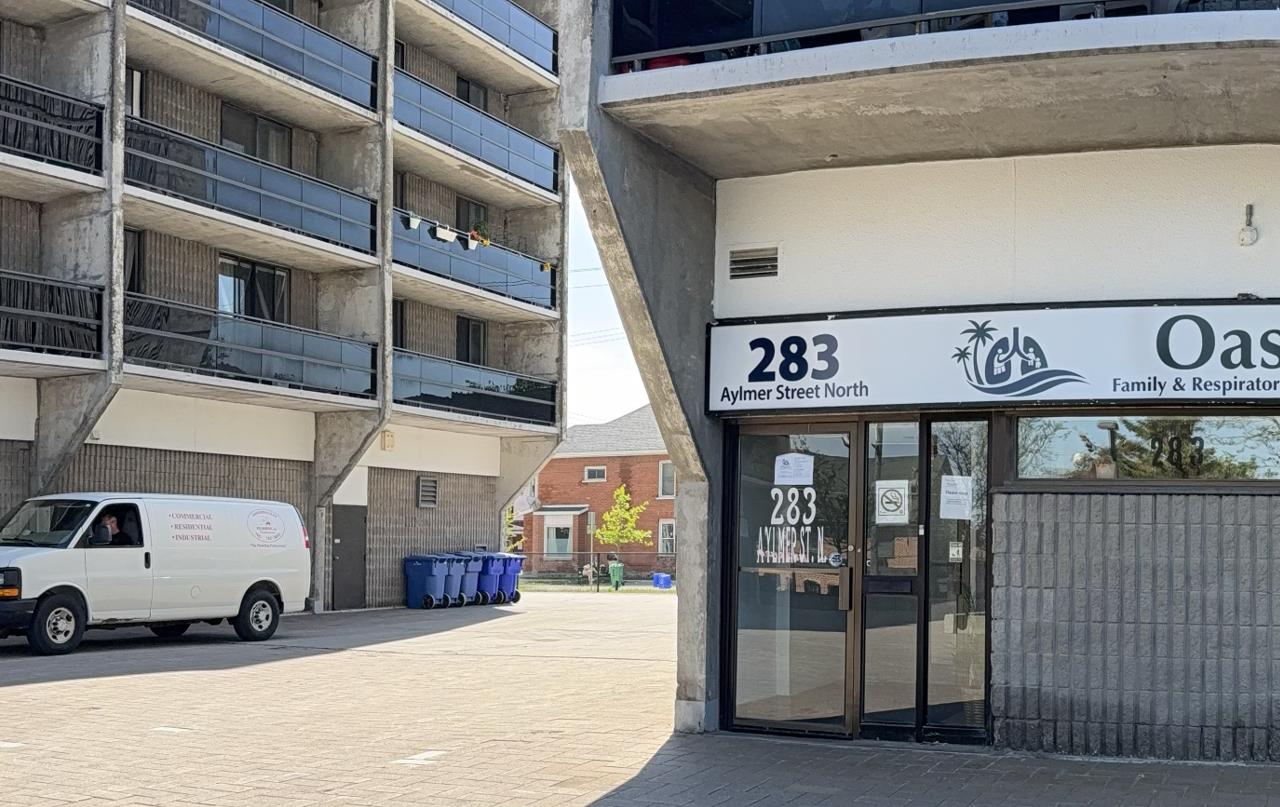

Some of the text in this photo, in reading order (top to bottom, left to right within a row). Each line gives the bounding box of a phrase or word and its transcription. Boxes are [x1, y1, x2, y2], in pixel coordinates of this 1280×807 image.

[748, 333, 839, 382] 283
[721, 381, 868, 405] Aylmer Street North
[1113, 377, 1167, 396] Family
[1173, 377, 1186, 392] &
[1151, 436, 1204, 467] 283
[770, 487, 817, 525] 283
